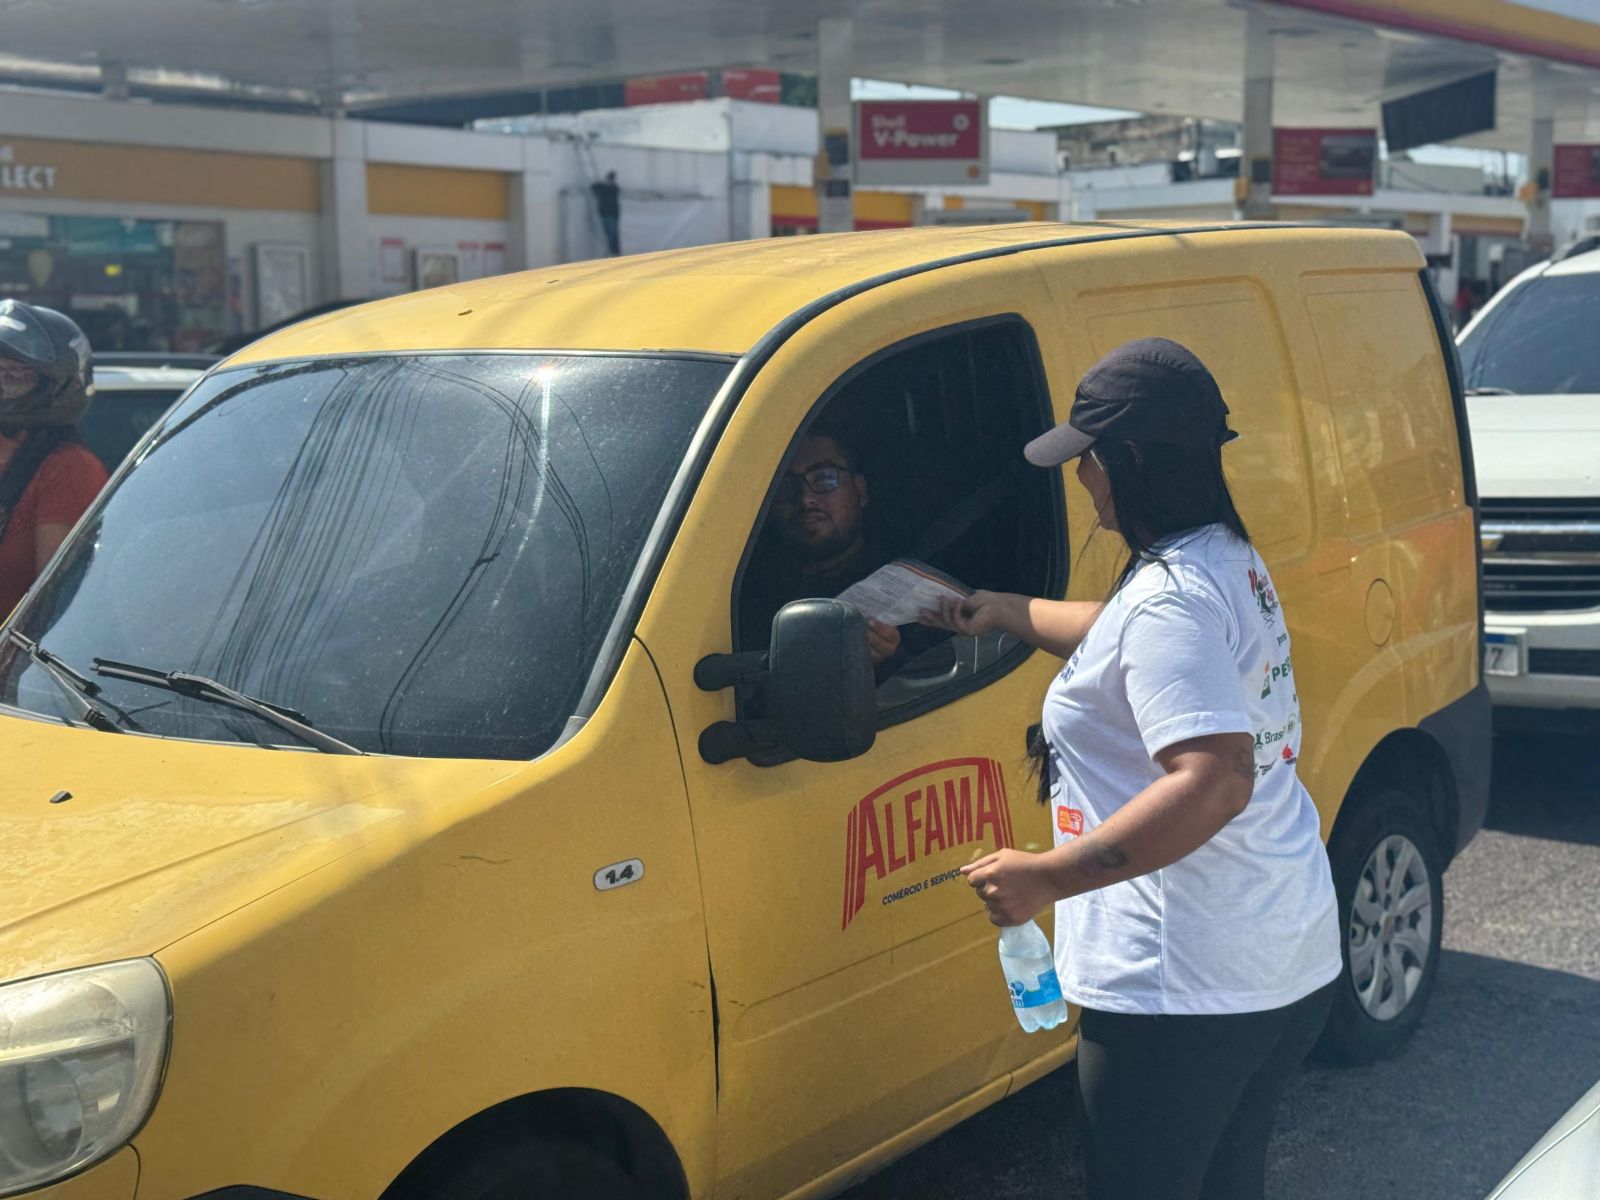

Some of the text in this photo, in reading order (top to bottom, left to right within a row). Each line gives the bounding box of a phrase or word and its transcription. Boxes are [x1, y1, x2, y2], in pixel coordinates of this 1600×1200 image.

[872, 130, 959, 148] V-Power
[854, 757, 1005, 916] ALFAMA
[605, 864, 634, 885] 1.4
[882, 882, 922, 905] COMÉRCIO
[923, 879, 929, 890] E
